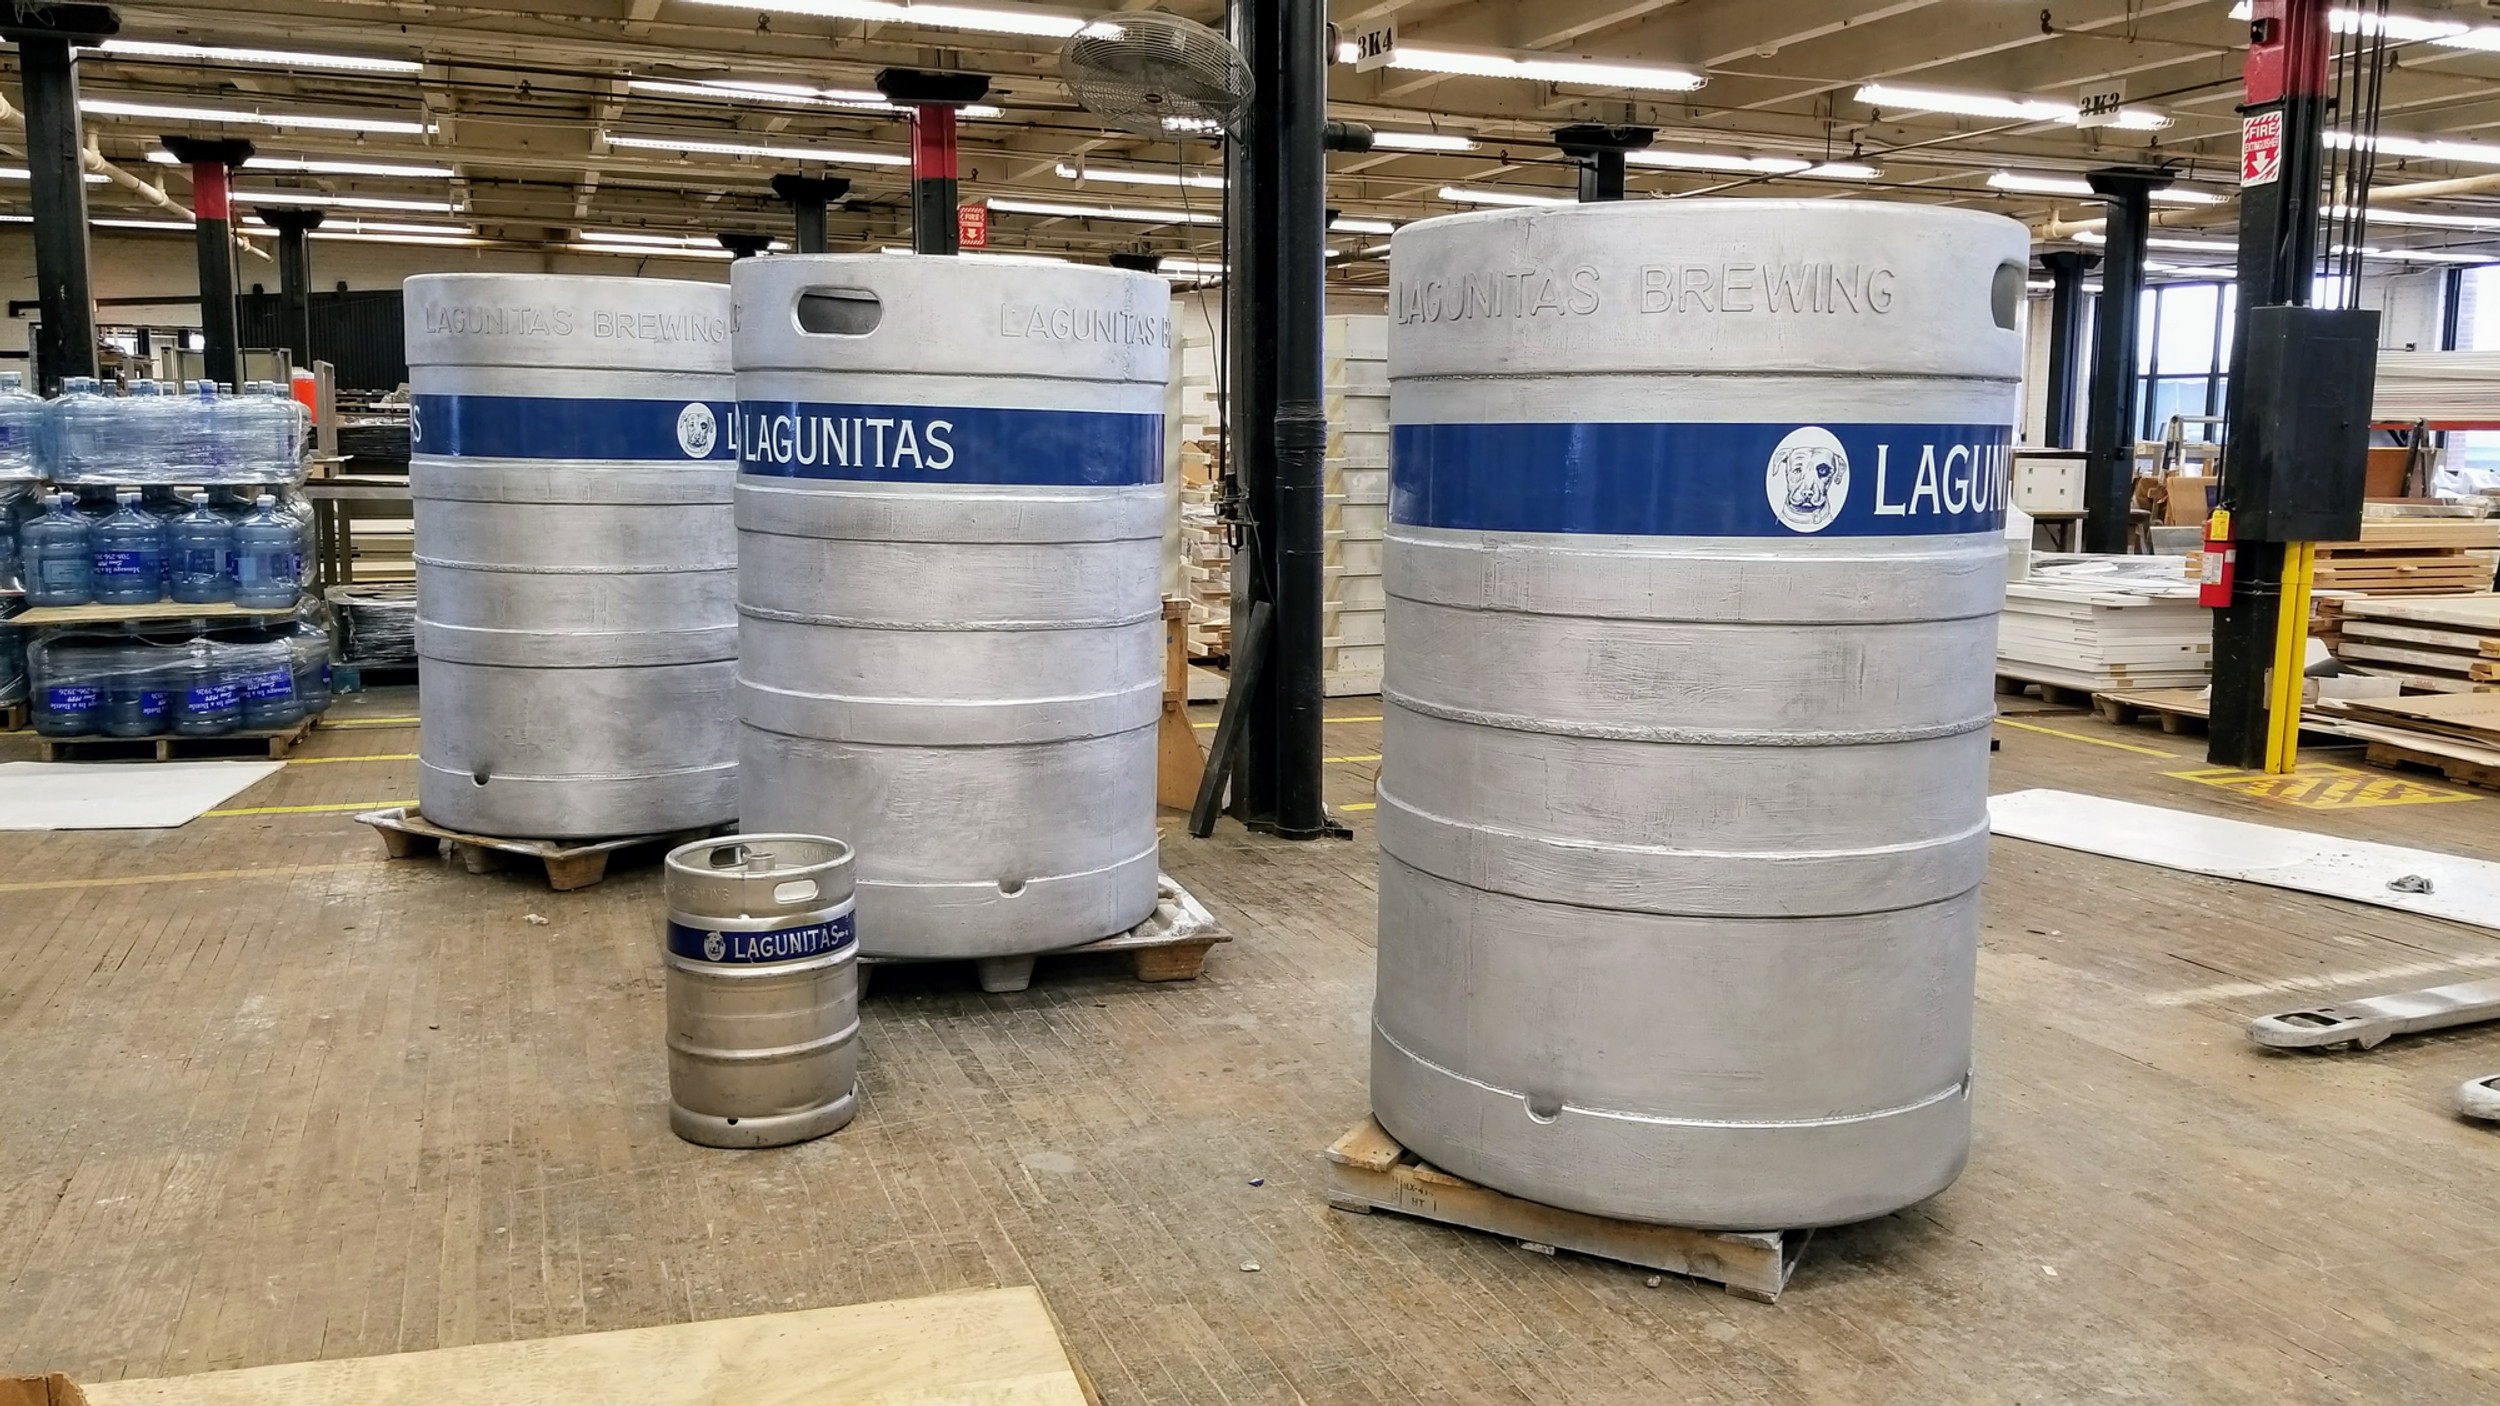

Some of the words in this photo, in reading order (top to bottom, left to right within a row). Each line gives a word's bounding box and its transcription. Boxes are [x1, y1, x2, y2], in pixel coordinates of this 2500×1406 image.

[1358, 27, 1394, 60] 3K4
[2081, 92, 2120, 117] 3K3
[2248, 122, 2276, 140] FIRE
[1398, 264, 1601, 325] LAGUNITAS
[1638, 262, 1897, 315] BREWING
[424, 305, 574, 337] LAGUNITAS
[593, 309, 726, 345] BREWING
[1000, 302, 1156, 346] LAGUNITAS
[744, 413, 955, 470] LAGUNITAS
[1873, 443, 2010, 517] LAGUNI
[734, 924, 840, 959] LAGUNITAS
